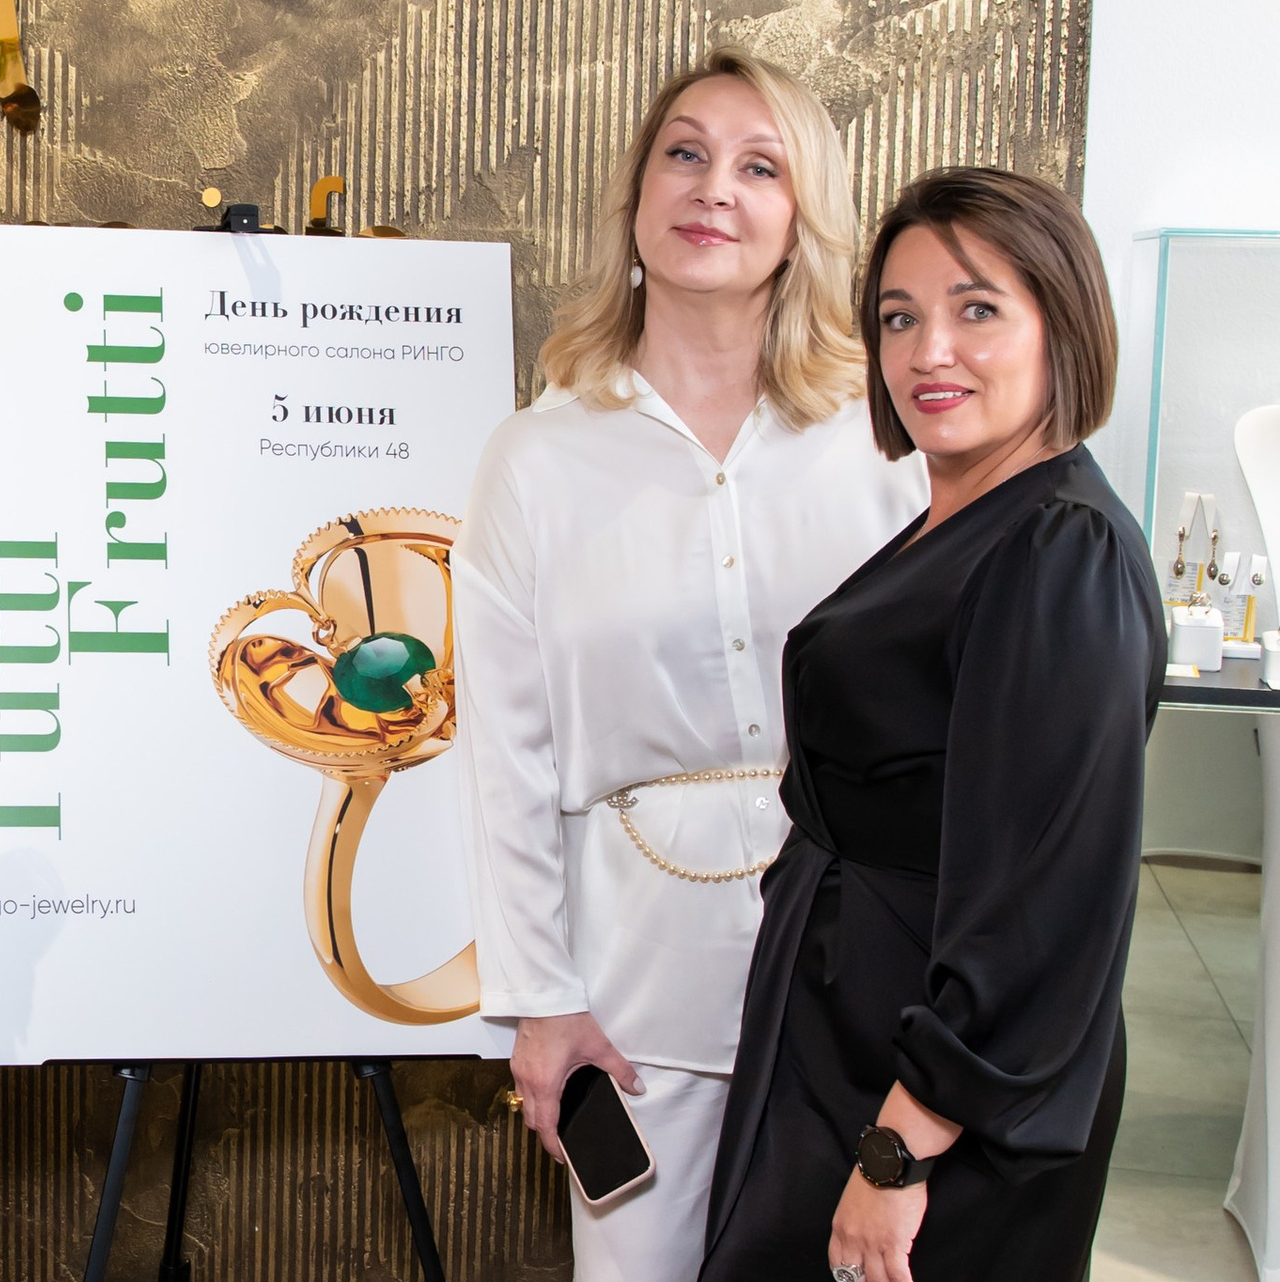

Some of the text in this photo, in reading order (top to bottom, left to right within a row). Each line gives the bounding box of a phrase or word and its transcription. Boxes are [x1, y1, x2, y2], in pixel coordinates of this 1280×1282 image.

[205, 290, 464, 328] День рождения
[204, 342, 464, 362] ювелирного салона РИНГО
[271, 393, 397, 426] 5 июня
[259, 438, 410, 461] Республики 48
[64, 287, 170, 666] Frutti
